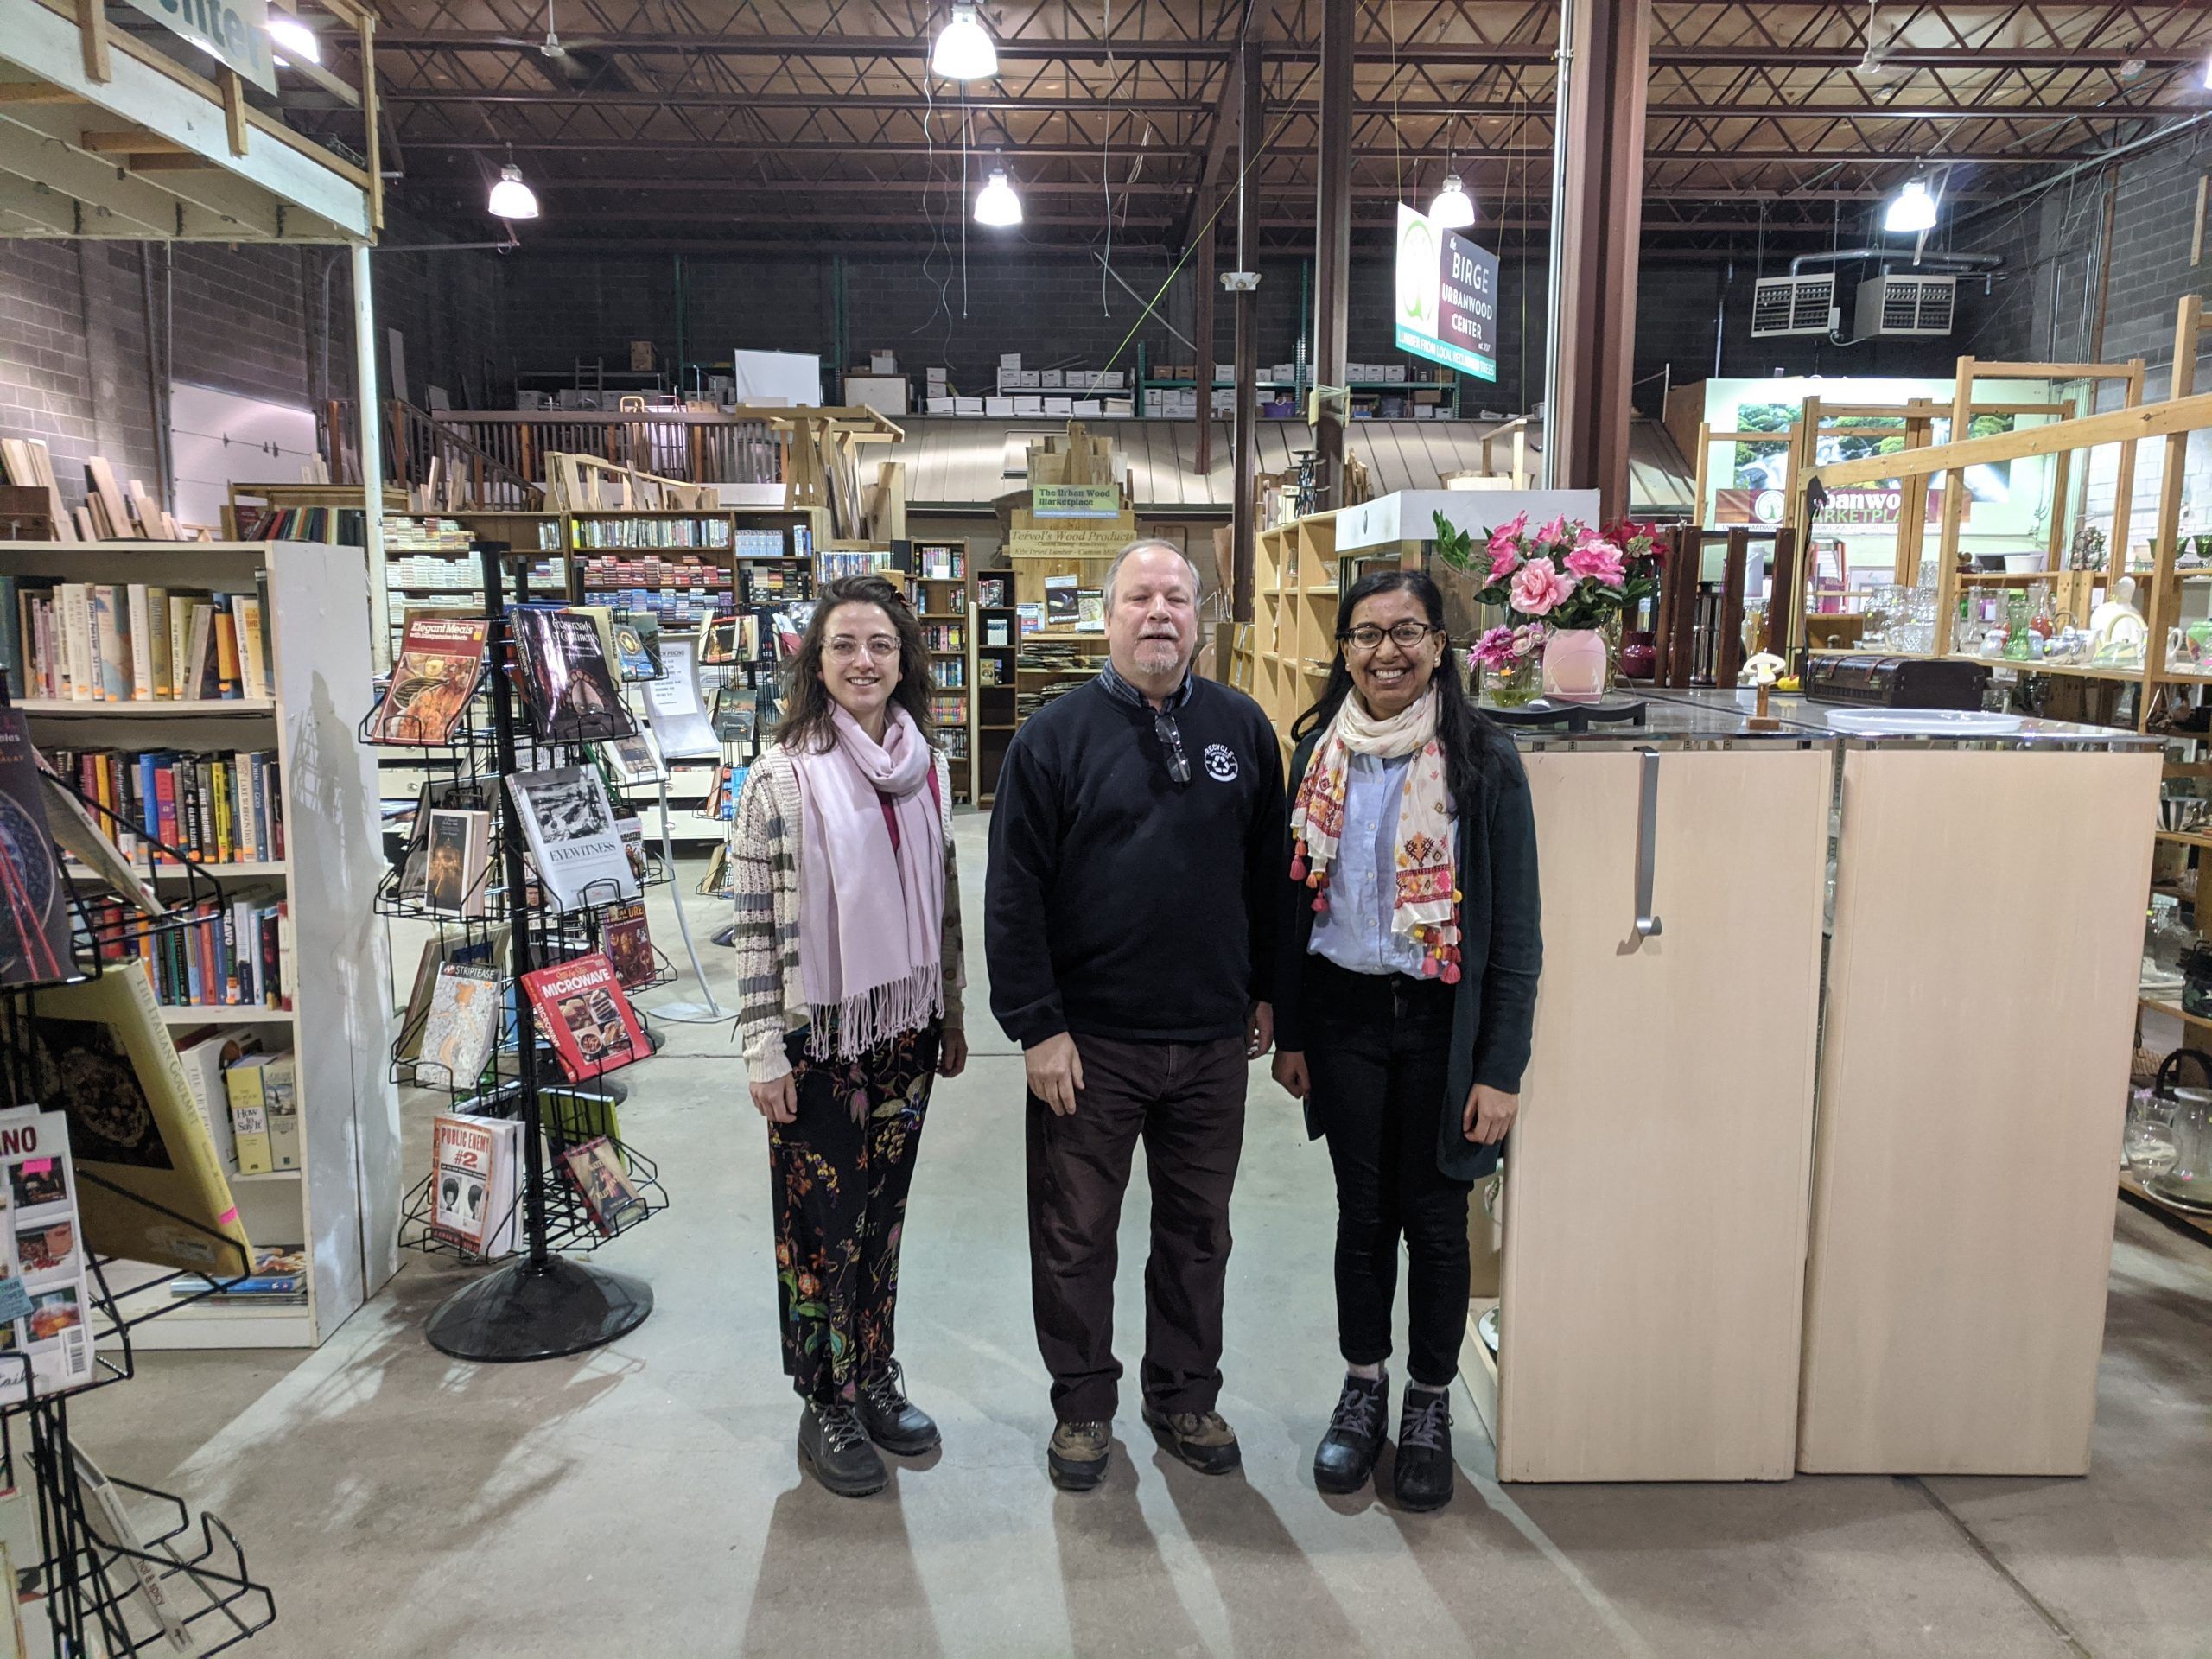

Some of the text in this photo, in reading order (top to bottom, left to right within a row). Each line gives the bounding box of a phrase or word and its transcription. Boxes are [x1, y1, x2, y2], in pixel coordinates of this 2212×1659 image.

[1452, 252, 1490, 294] BIRGE
[1441, 283, 1493, 321] URBANWOOD
[1452, 313, 1482, 340] CENTER
[1039, 498, 1095, 507] Marketplace
[1055, 530, 1086, 541] Wood
[1089, 531, 1135, 541] Products
[411, 622, 474, 634] Elegant Meals
[1205, 744, 1235, 760] RECYCLE
[240, 779, 249, 796] LAKE
[200, 807, 212, 843] TOMORROW
[550, 842, 616, 862] EYEWITNESS
[223, 908, 233, 945] BRAVO
[455, 965, 494, 979] STRIPTEASE
[542, 969, 611, 998] MICROWAVE
[536, 1002, 561, 1048] MICROWAVE
[137, 977, 199, 1124] THE ITALIAN GOURMET
[237, 1109, 257, 1119] How
[238, 1123, 254, 1133] Say
[255, 1121, 263, 1129] It
[442, 1127, 490, 1154] PUBLIC ENEMY
[454, 1149, 478, 1168] #2
[149, 1584, 165, 1605] spicy
